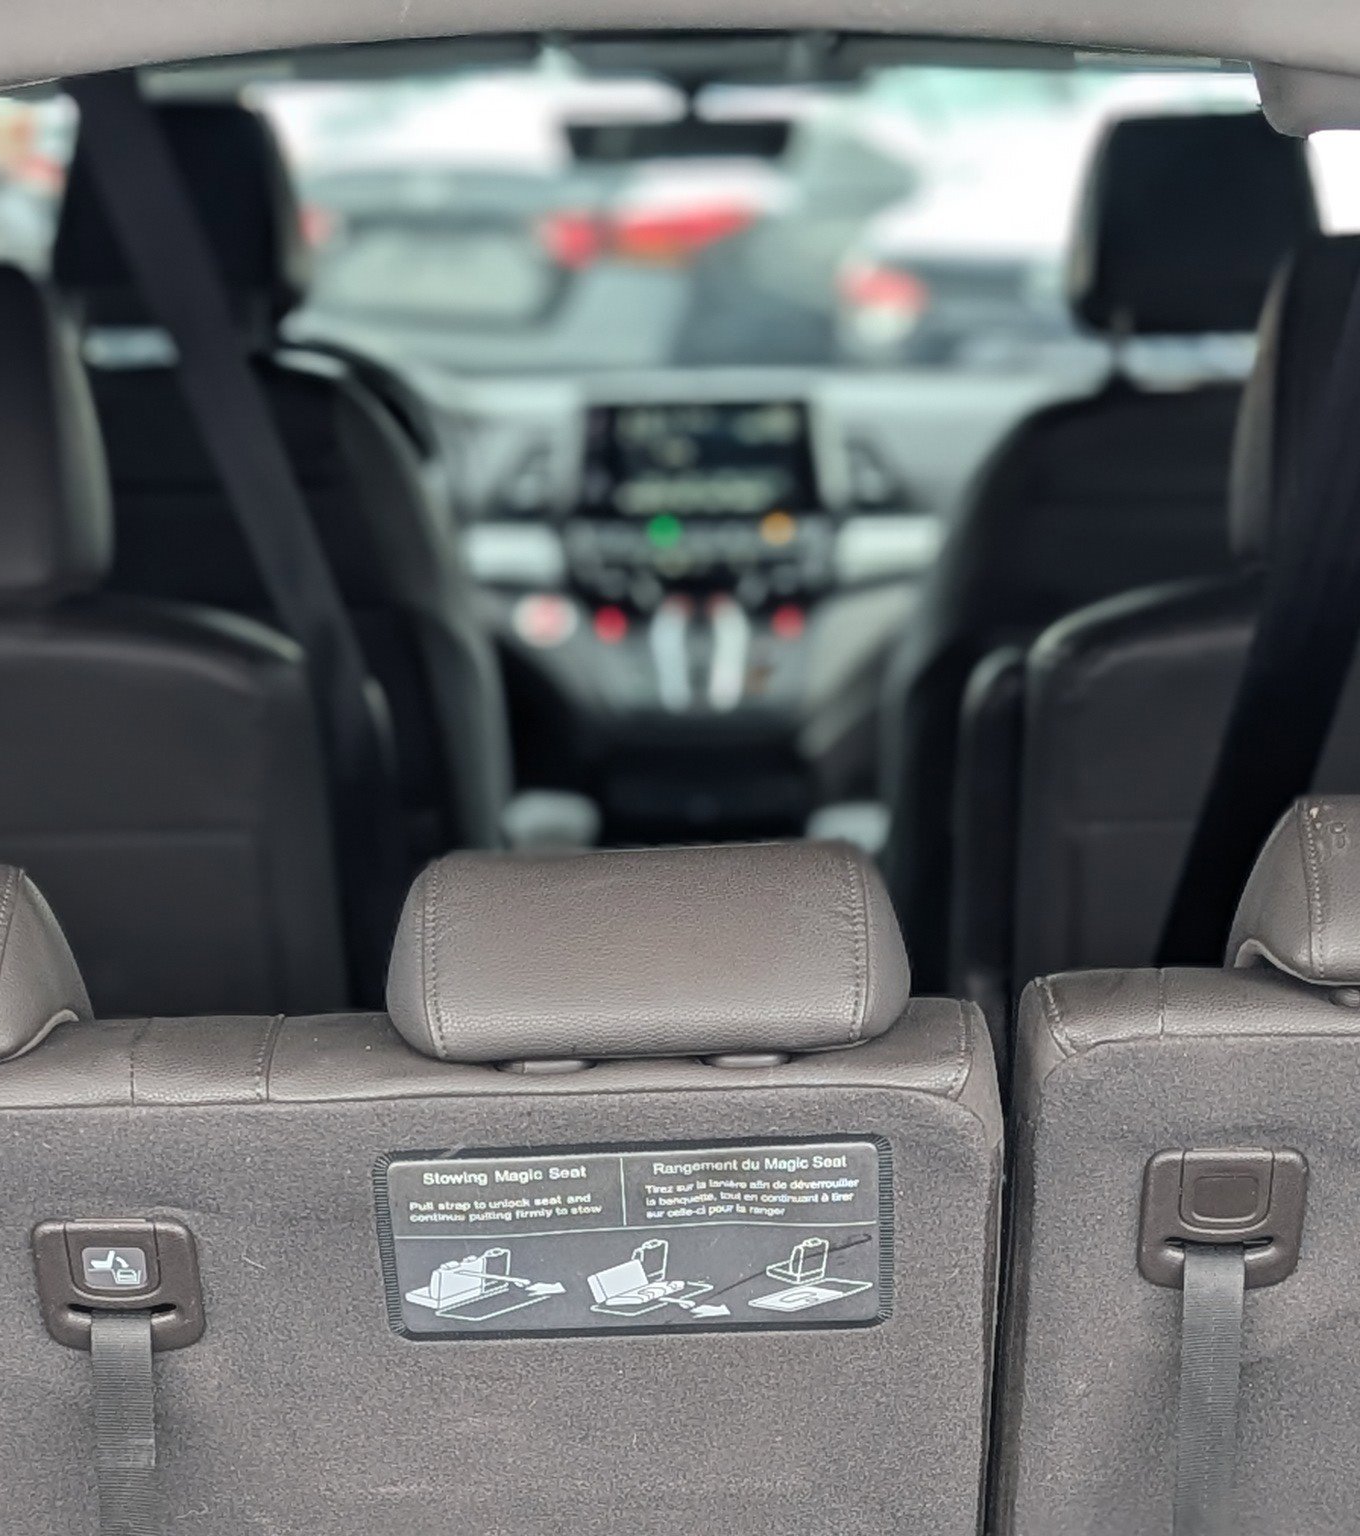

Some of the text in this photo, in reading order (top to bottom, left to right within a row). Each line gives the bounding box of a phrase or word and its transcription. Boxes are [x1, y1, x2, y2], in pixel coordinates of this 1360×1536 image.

[653, 1155, 847, 1175] Rangement du Magic Seat
[423, 1166, 587, 1186] Stowing Magic Seat
[645, 1184, 673, 1194] Tirez
[696, 1180, 706, 1189] la
[773, 1180, 787, 1190] de
[409, 1193, 591, 1212] Pull strap to unlock seat and
[744, 1193, 758, 1202] en
[516, 1207, 553, 1219] firmly
[555, 1206, 568, 1216] to
[570, 1205, 602, 1215] stow
[708, 1204, 734, 1216] pour
